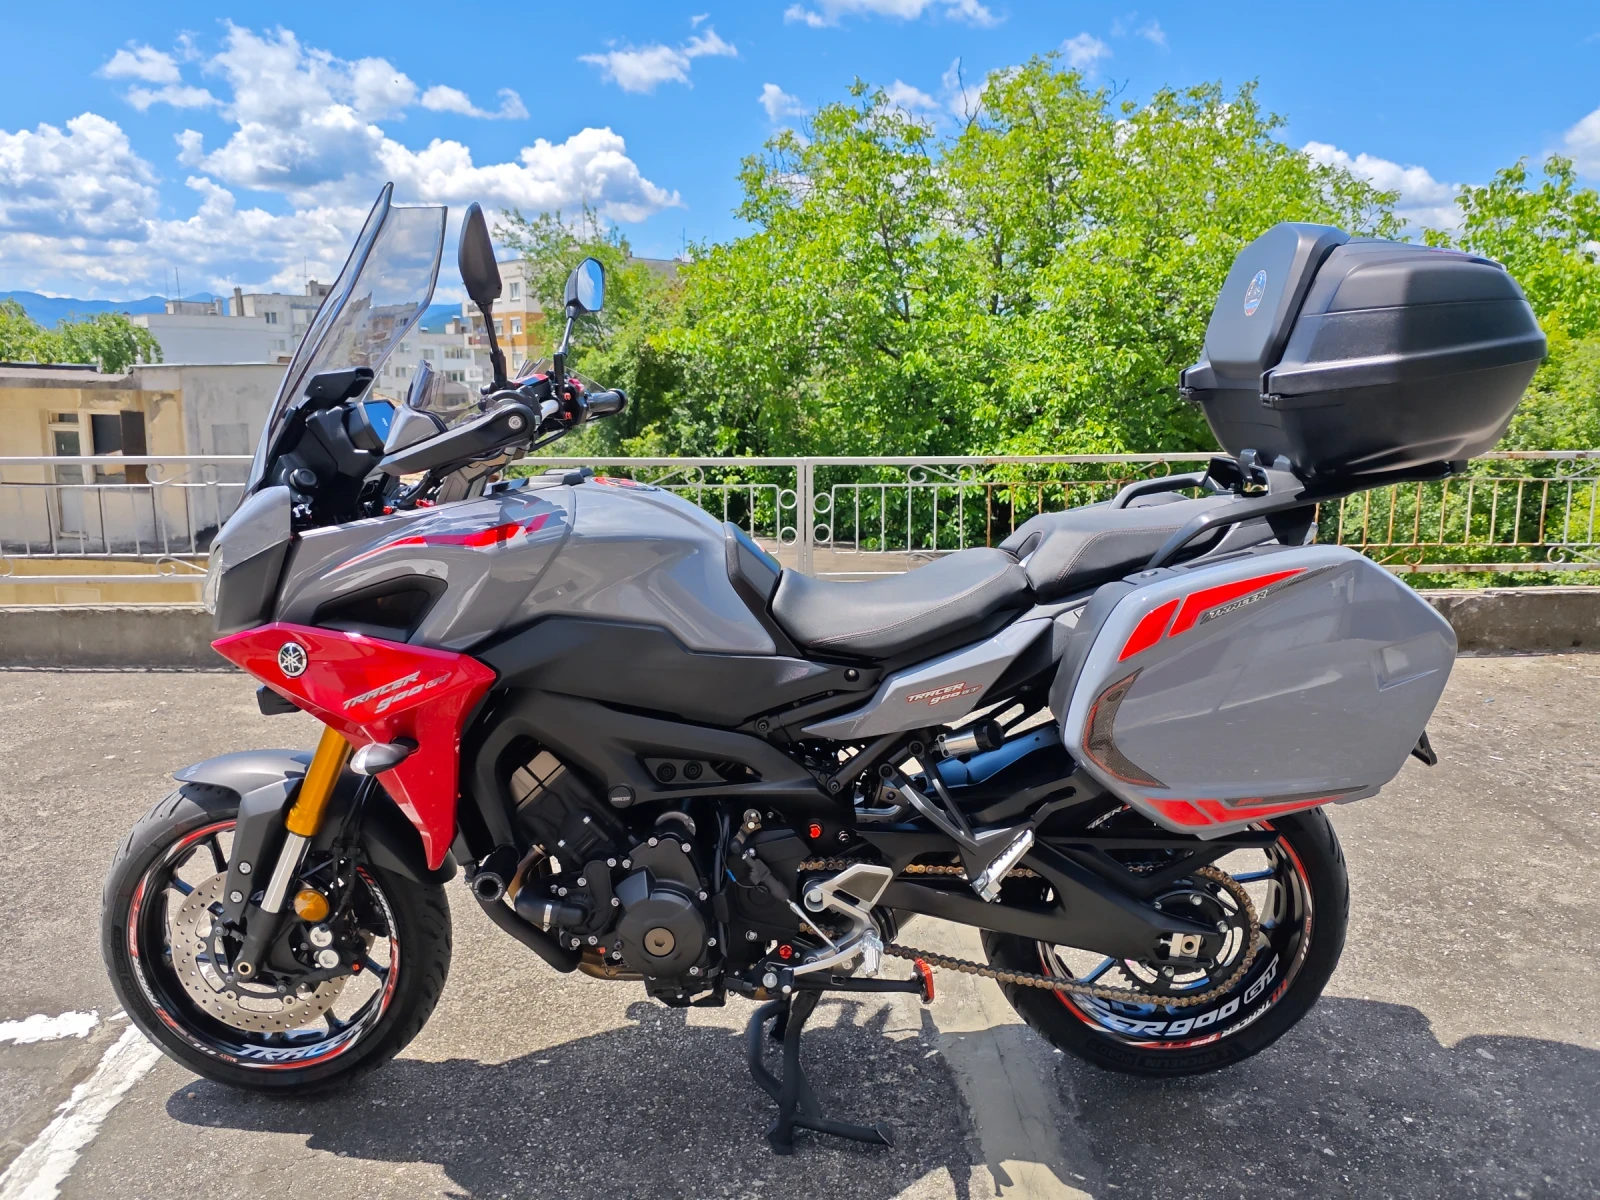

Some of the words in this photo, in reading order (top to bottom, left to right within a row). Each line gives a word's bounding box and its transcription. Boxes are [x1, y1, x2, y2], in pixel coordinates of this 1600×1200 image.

[1209, 589, 1268, 618] TRACER
[342, 670, 421, 710] TRACER
[374, 683, 425, 715] 900
[425, 672, 452, 690] GT
[907, 682, 965, 702] TRACER
[929, 691, 961, 705] 900
[1164, 997, 1240, 1036] 900
[1243, 953, 1280, 1005] GT
[1221, 1000, 1271, 1038] TRACER
